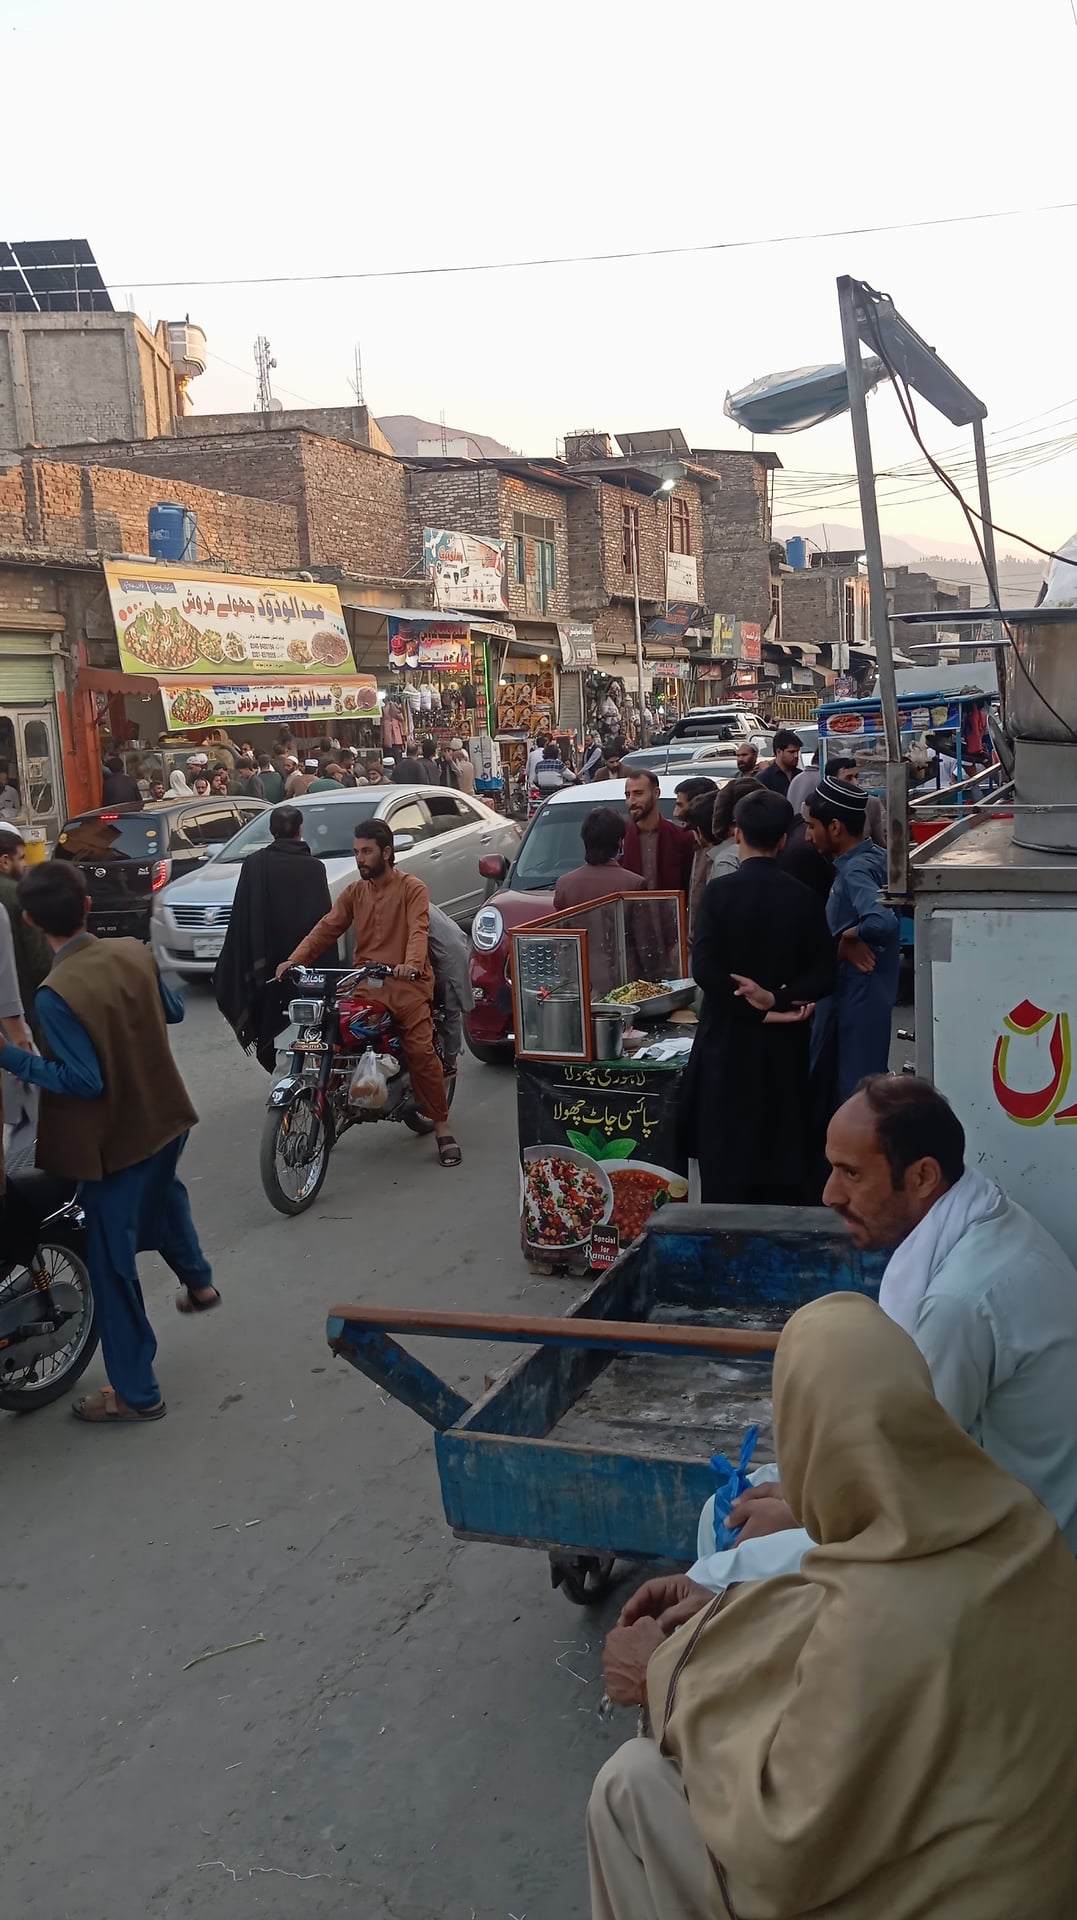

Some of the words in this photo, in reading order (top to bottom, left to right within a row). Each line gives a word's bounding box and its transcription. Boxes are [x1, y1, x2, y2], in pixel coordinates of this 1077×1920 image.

[182, 589, 215, 616] فروش
[217, 593, 255, 622] چھولے
[257, 596, 301, 624] الودود
[301, 601, 325, 625] عبد
[237, 692, 259, 713] فروش
[259, 693, 286, 712] چھولے
[287, 689, 316, 712] الودود
[316, 691, 333, 711] عبد
[554, 1098, 586, 1126] چھولا
[582, 1106, 618, 1136] چاٹ
[594, 1234, 616, 1245] Special
[600, 1245, 610, 1253] for
